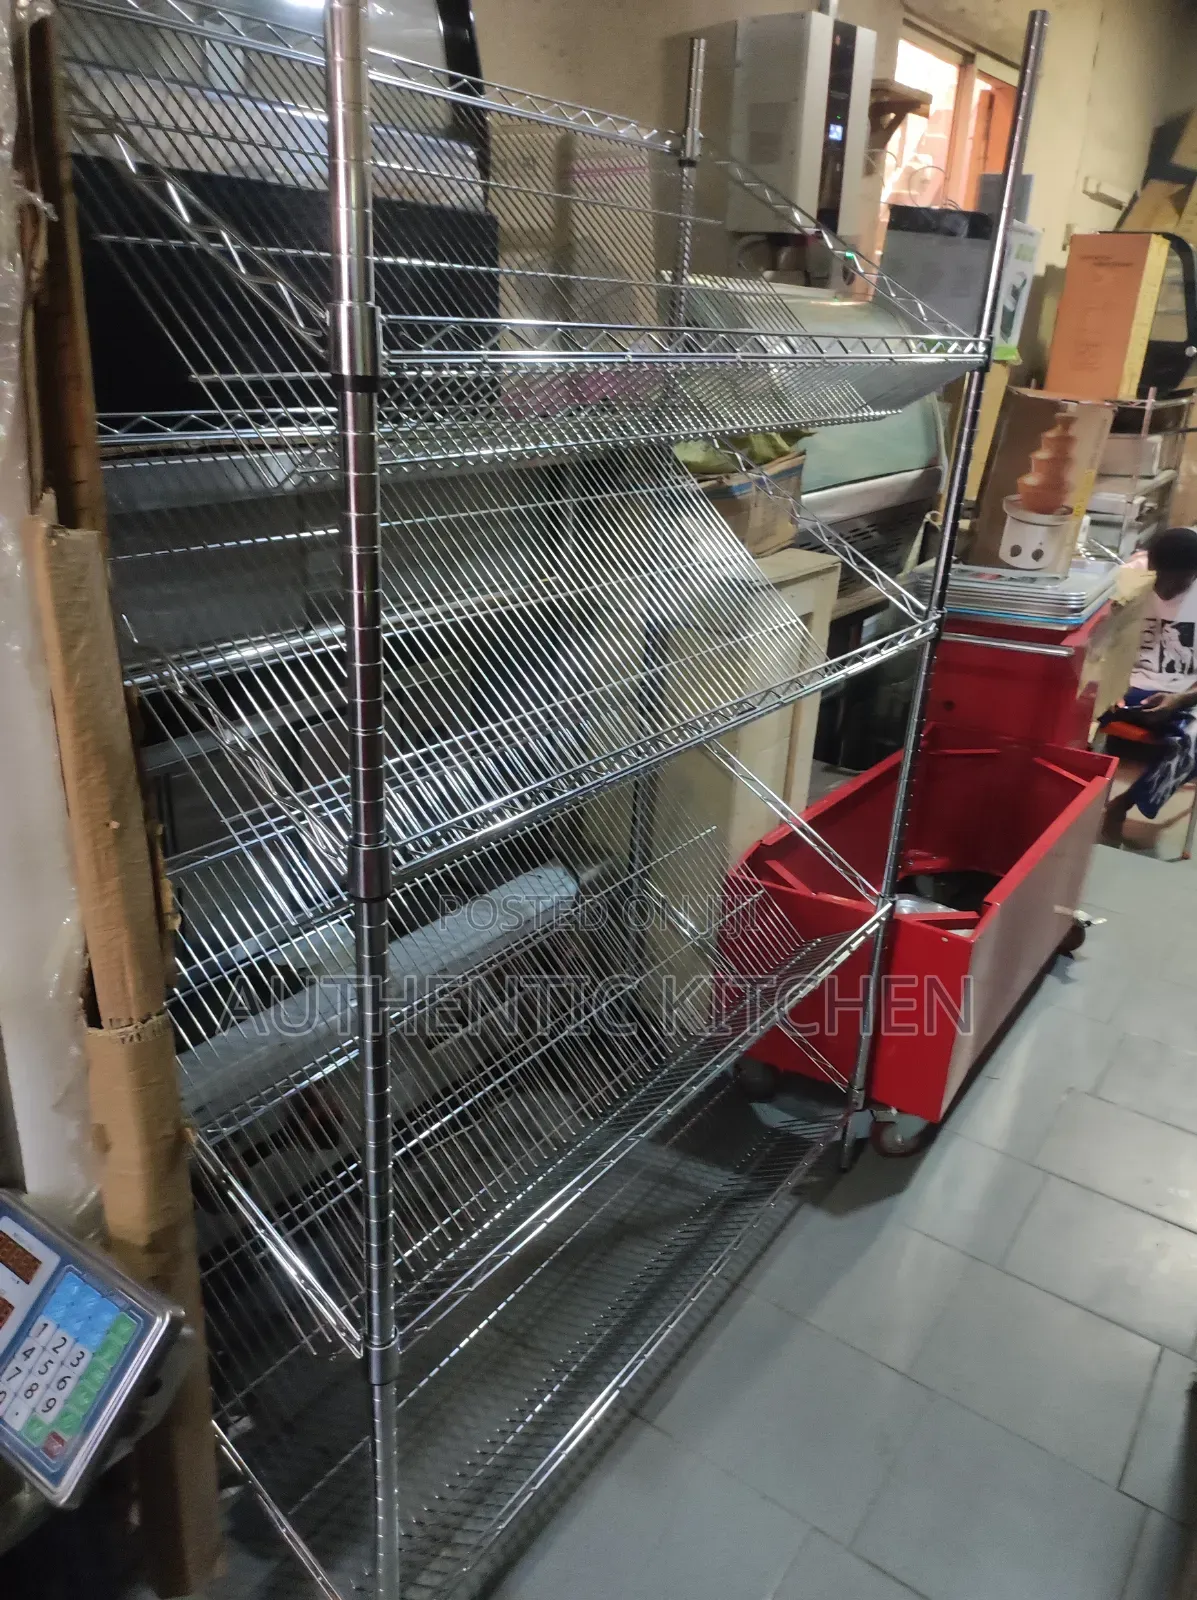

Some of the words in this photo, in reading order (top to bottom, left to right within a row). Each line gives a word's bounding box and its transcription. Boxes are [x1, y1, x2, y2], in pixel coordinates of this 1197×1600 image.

[35, 1322, 49, 1338] 1
[52, 1336, 67, 1354] 2
[70, 1350, 85, 1368] 3
[6, 1366, 22, 1382] 7
[23, 1382, 39, 1399] 8
[41, 1397, 57, 1413] 9
[22, 1346, 36, 1361] 4
[37, 1359, 54, 1375] 5
[56, 1375, 72, 1391] 6
